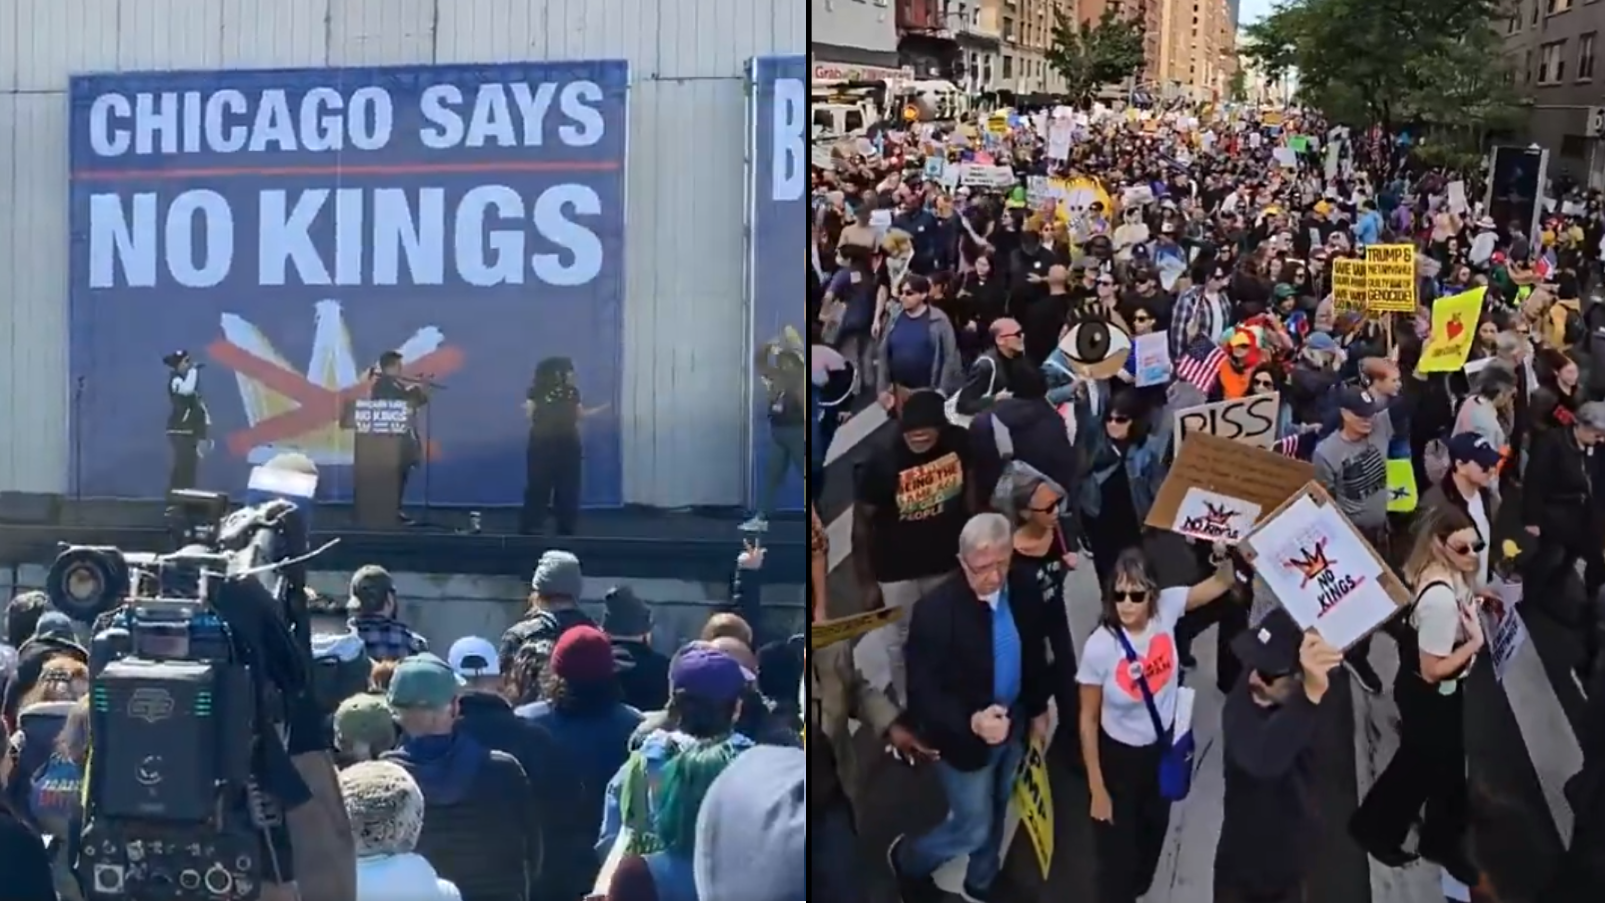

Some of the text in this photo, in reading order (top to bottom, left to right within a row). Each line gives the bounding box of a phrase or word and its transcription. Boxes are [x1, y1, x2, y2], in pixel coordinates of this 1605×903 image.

[815, 65, 842, 79] Grab
[89, 80, 604, 156] CHICAGO SAYS
[89, 183, 603, 288] NO KINGS
[1367, 248, 1412, 262] TRUMP &
[1180, 398, 1274, 442] PISS
[1183, 516, 1203, 531] NO
[1317, 569, 1336, 589] NO
[1317, 574, 1356, 612] KINGS
